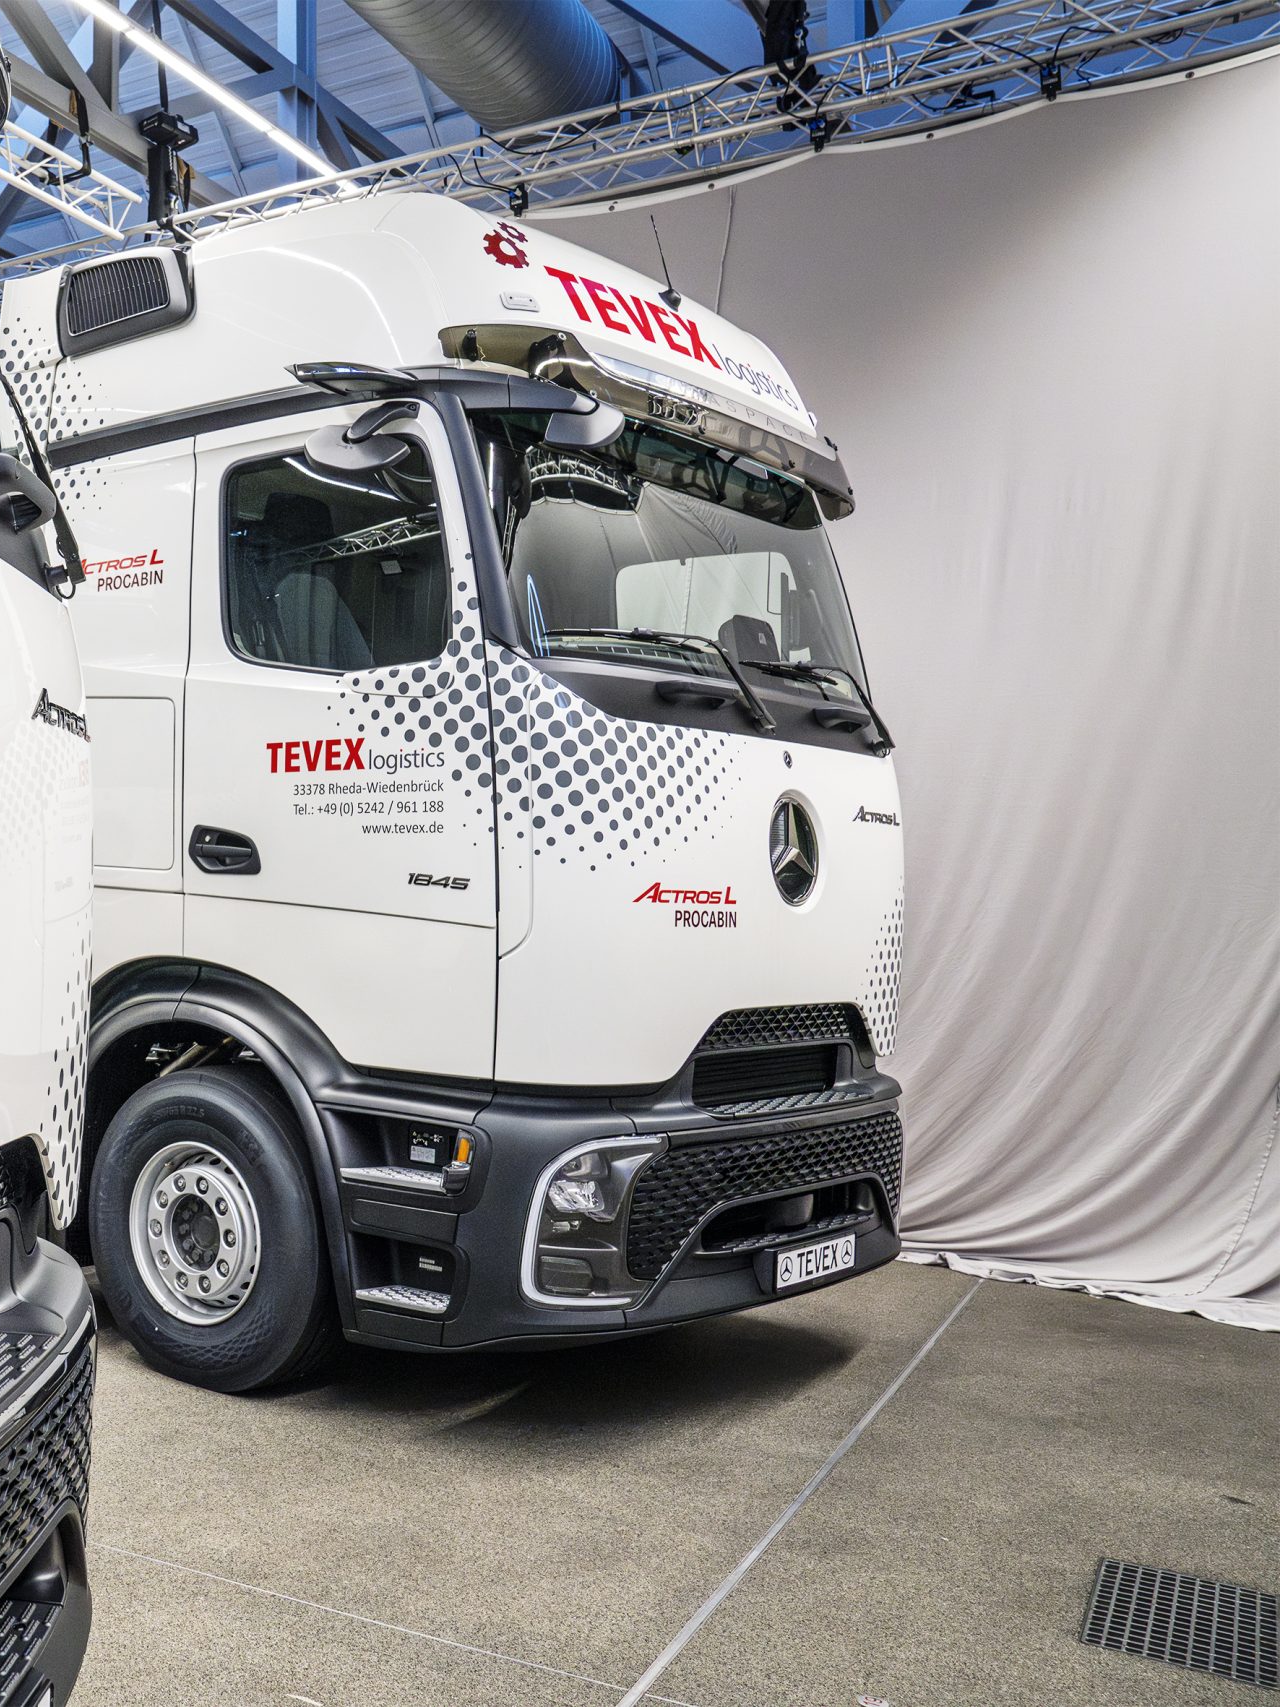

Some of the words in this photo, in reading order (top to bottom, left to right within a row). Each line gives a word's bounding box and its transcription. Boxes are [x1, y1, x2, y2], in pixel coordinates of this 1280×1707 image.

[543, 265, 721, 369] TEVEX
[712, 343, 799, 411] logistics
[97, 570, 164, 592] PROCABIN
[265, 737, 366, 774] TEVEX
[368, 749, 445, 775] logistics
[293, 783, 326, 796] 33378
[328, 779, 444, 795] Rheda-Wiedenbrück
[293, 803, 315, 816] Tel.:
[317, 802, 337, 815] +49
[339, 801, 354, 817] (0)
[357, 801, 385, 814] 5242
[387, 800, 394, 816] /
[396, 801, 418, 814] 961
[422, 800, 444, 813] 188
[852, 805, 892, 825] ACTROS
[361, 821, 444, 834] www.tevex.de
[408, 872, 471, 890] 1845
[632, 882, 722, 904] ACTROS
[723, 886, 737, 904] L
[674, 910, 737, 928] PROCABIN
[797, 1242, 838, 1278] TEVEX
